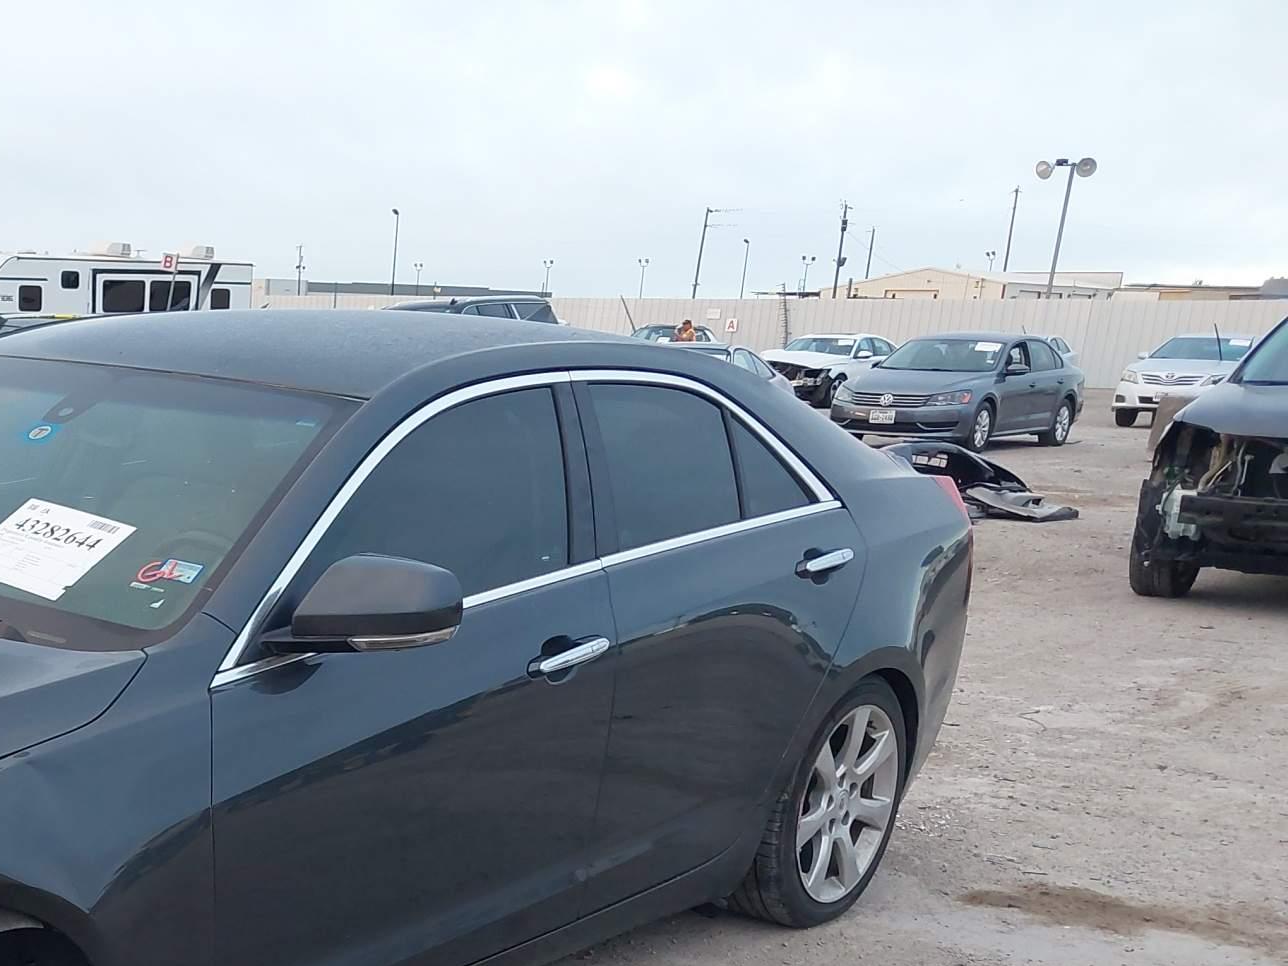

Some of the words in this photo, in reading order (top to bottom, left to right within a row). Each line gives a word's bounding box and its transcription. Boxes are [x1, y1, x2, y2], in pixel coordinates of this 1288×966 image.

[163, 255, 173, 268] B
[727, 319, 735, 330] A
[14, 517, 105, 552] 43282644
